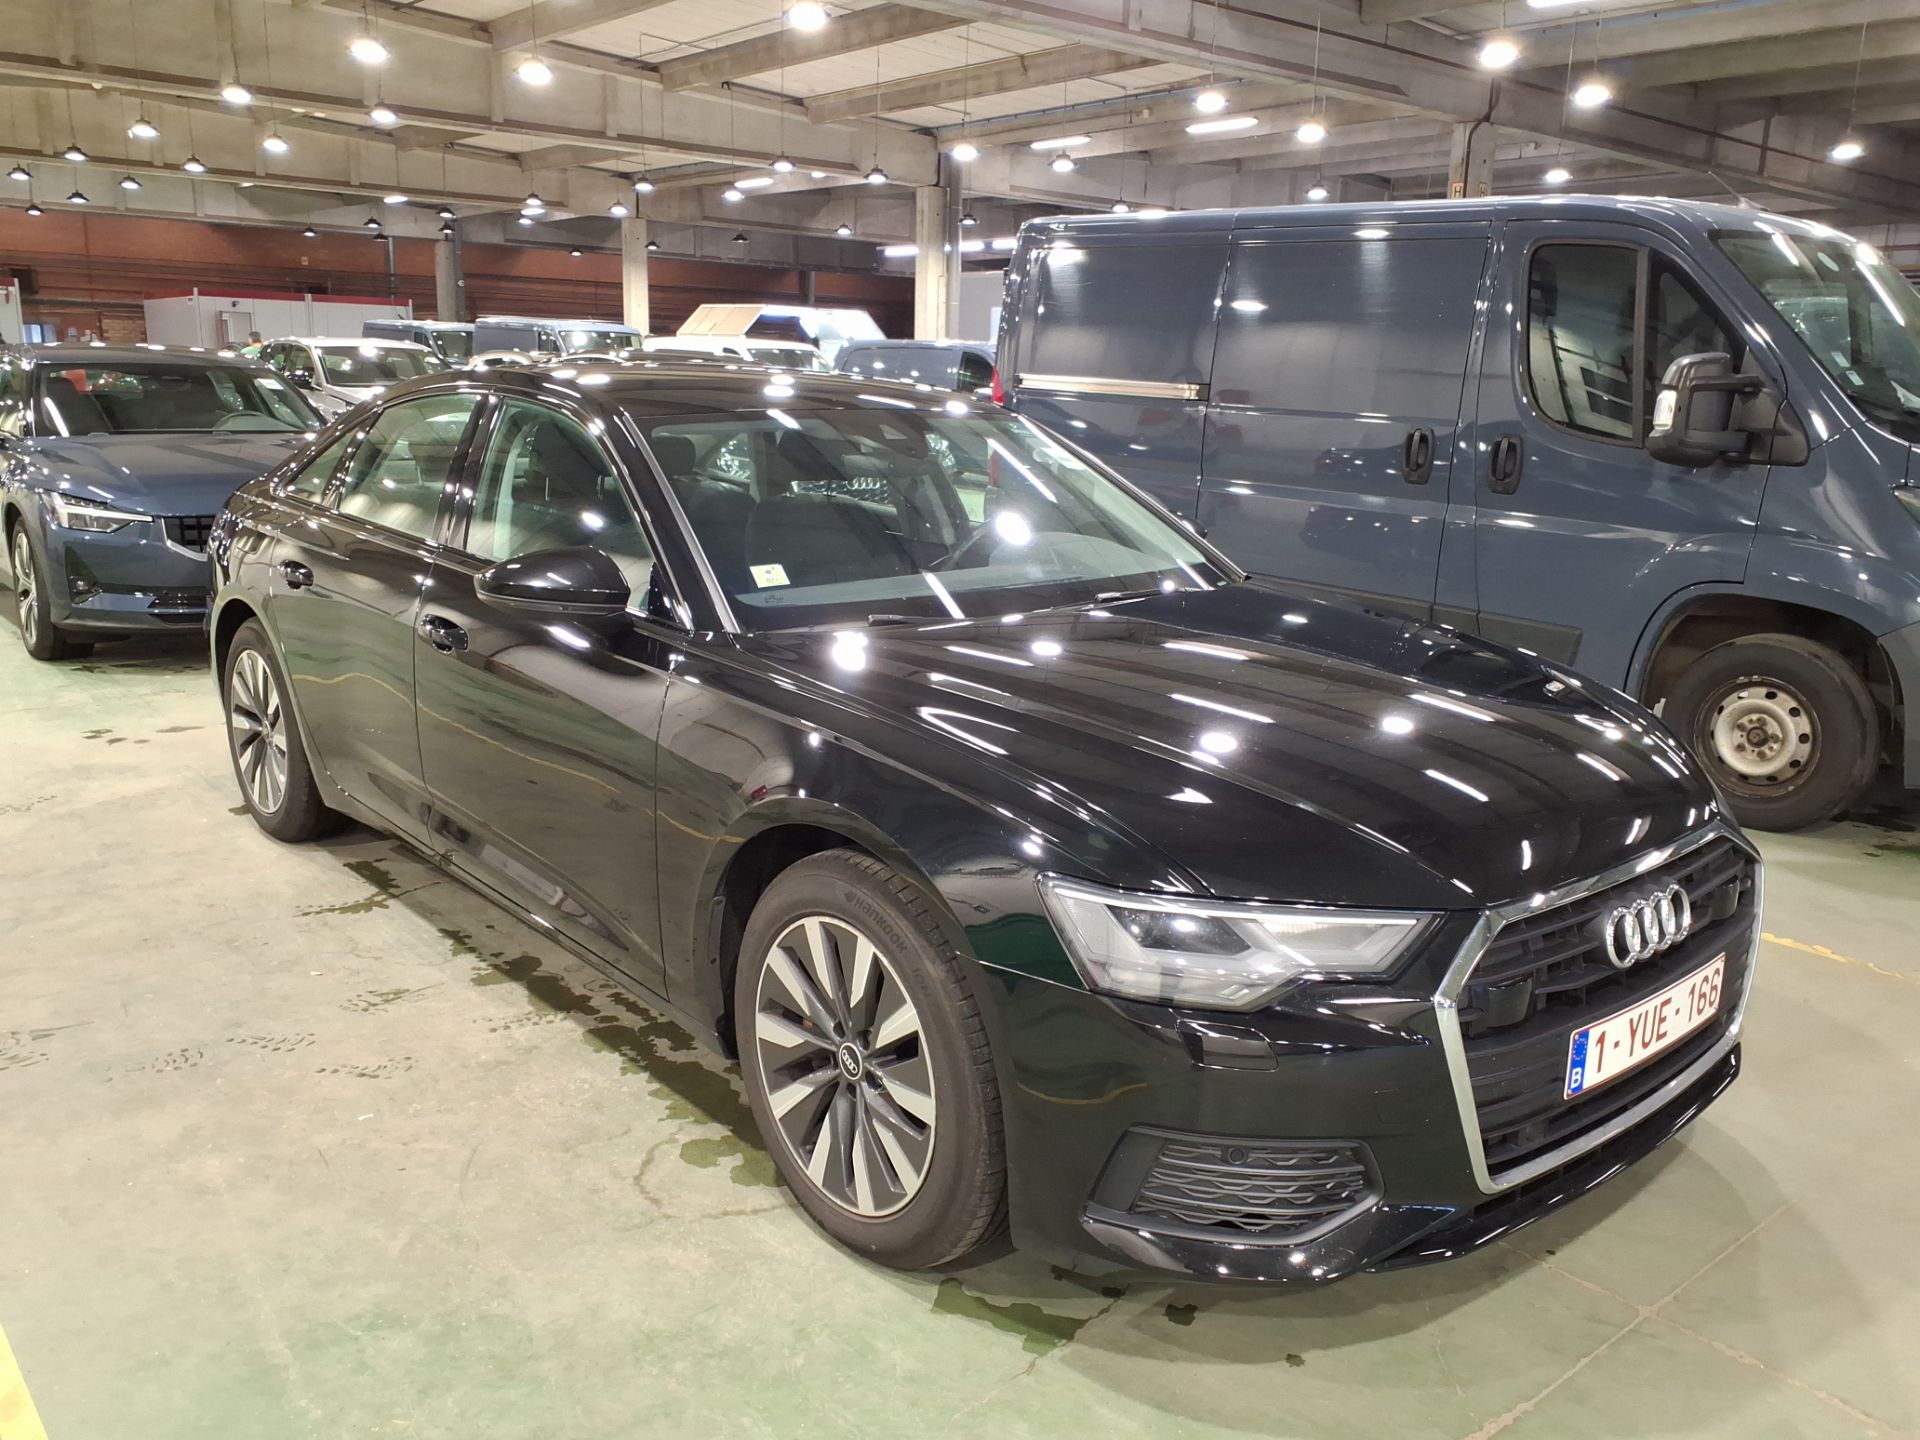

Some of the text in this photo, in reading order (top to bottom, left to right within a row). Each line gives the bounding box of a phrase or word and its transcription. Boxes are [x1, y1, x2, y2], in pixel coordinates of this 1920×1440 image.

[1454, 185, 1462, 198] H
[1595, 967, 1721, 1074] 1-YUE-166
[1570, 1067, 1582, 1089] B
